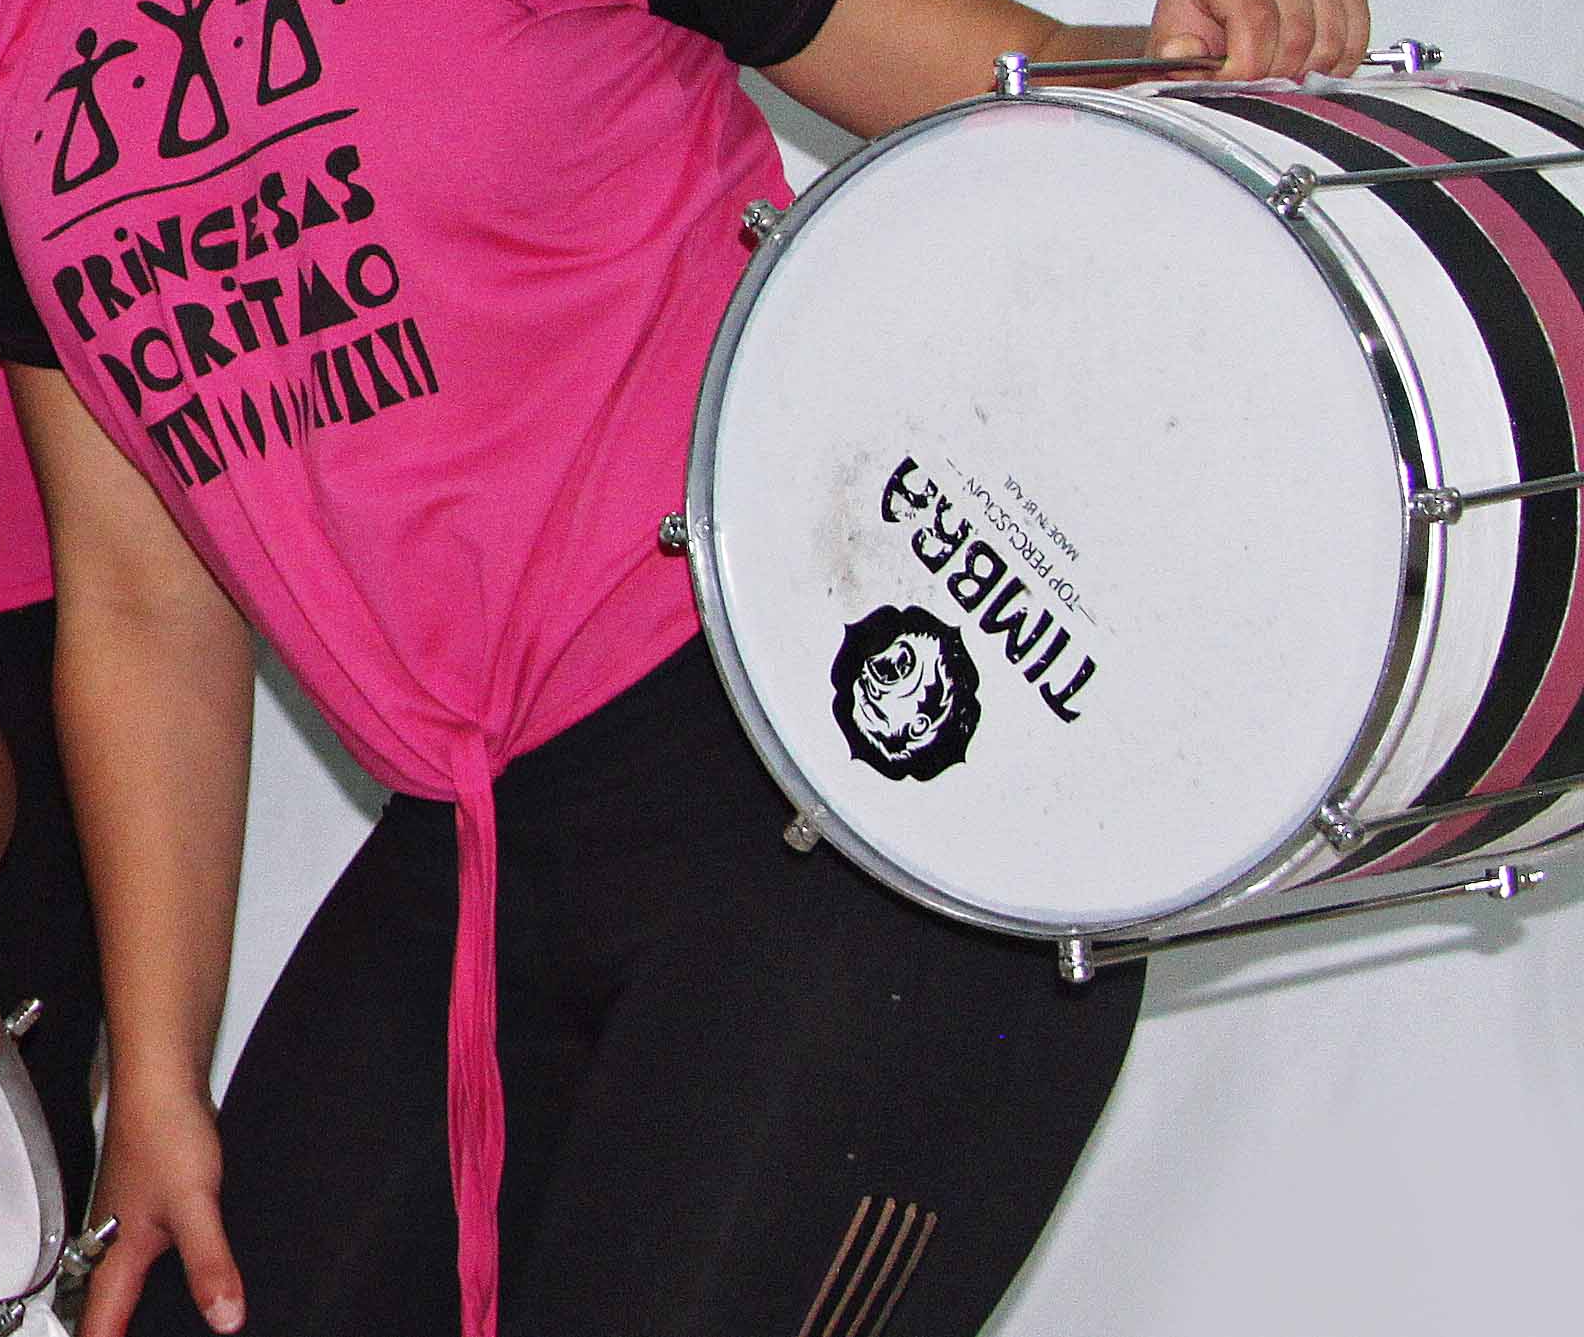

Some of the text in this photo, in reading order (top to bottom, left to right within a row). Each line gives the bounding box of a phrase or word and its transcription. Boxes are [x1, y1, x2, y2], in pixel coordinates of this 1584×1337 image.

[1047, 525, 1080, 561] MADE
[881, 455, 1097, 724] TIMBRA
[1048, 578, 1081, 612] TOP
